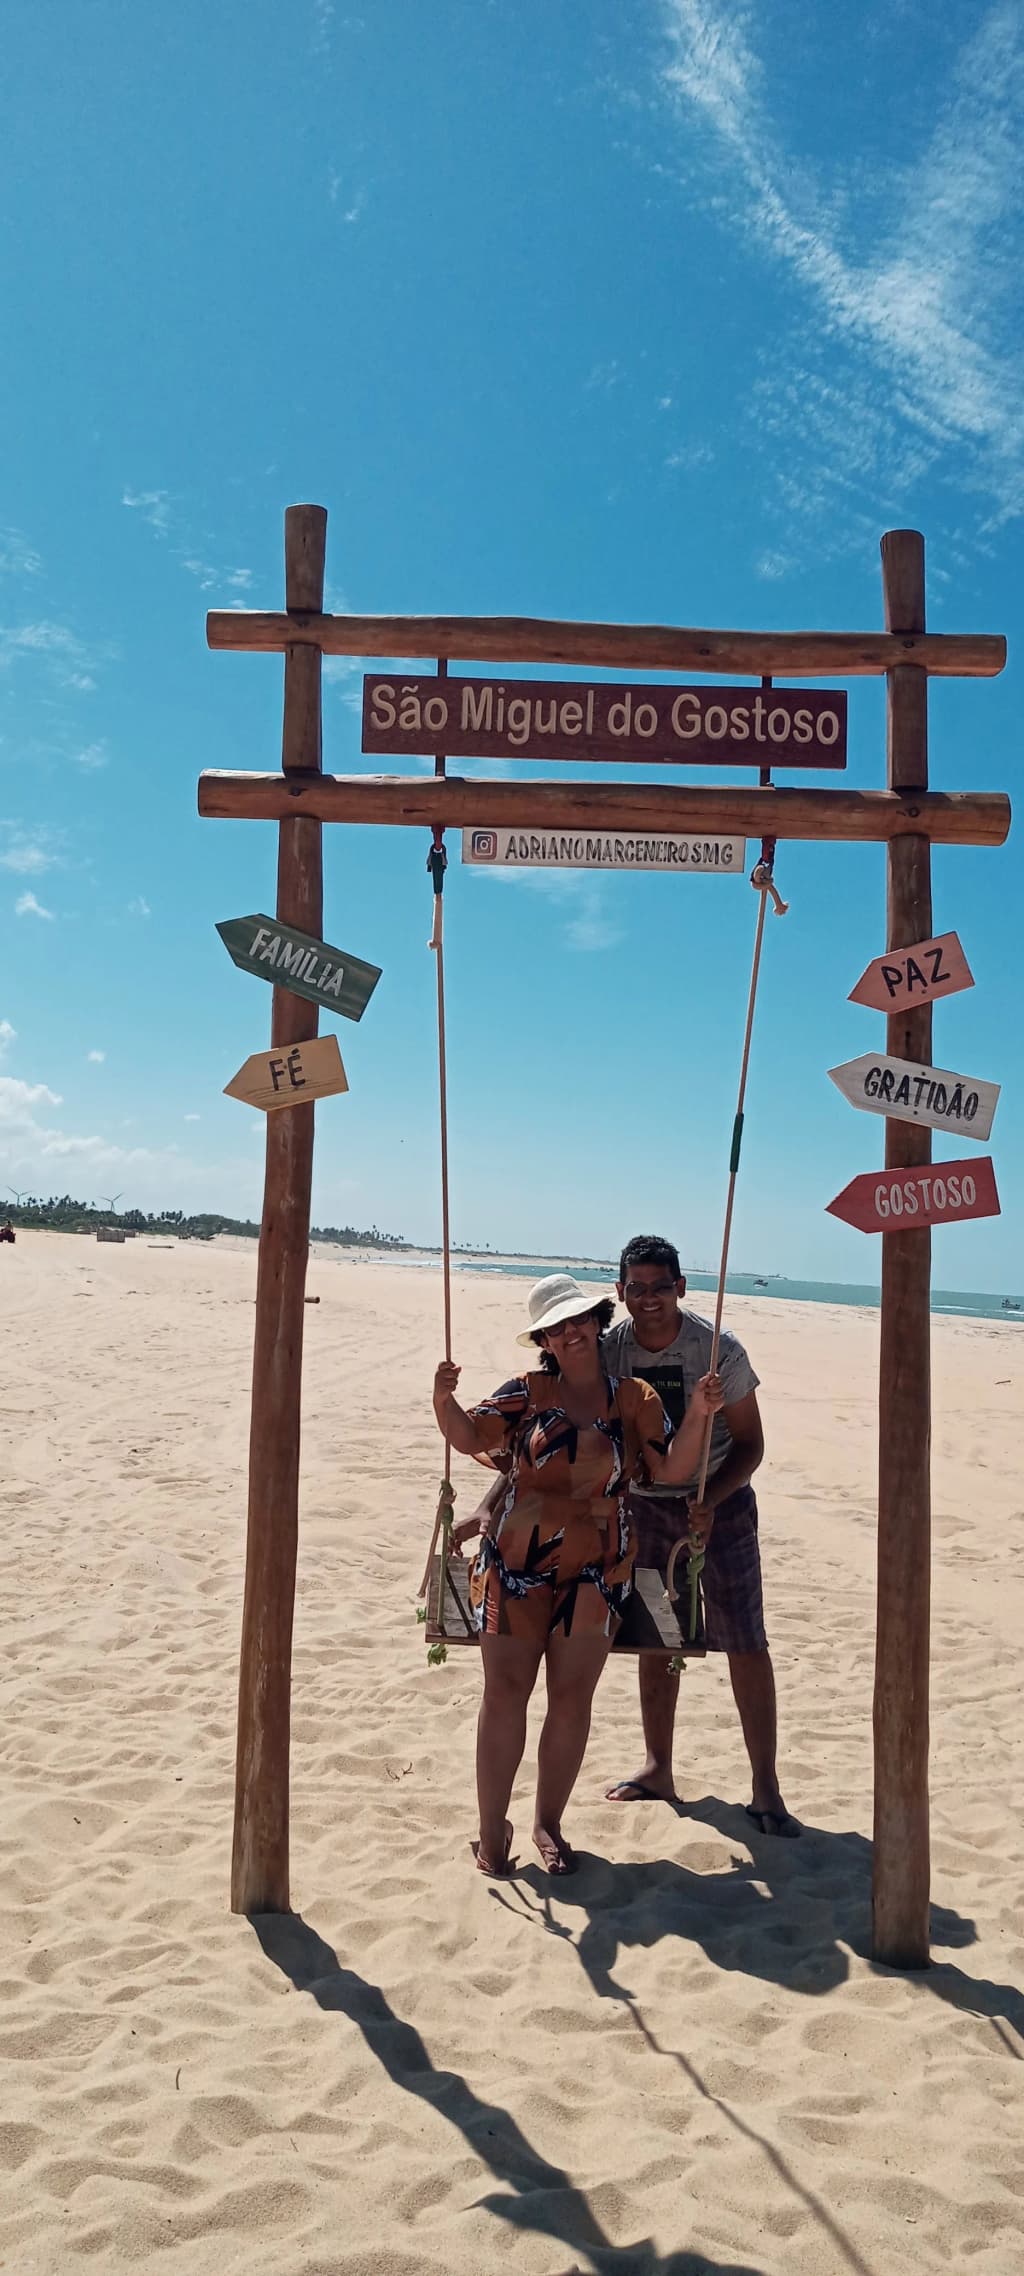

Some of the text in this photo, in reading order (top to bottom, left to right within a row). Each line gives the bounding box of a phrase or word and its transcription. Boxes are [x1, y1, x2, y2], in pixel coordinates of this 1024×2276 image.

[370, 683, 840, 746] São Miguel do Gostoso
[504, 835, 734, 865] ADRIANOMARCENEIROSMG
[249, 928, 344, 997] FAMÍLIA
[881, 948, 951, 998] PAZ
[269, 1048, 306, 1092] FÉ
[864, 1067, 979, 1122] GRATIDÃO
[874, 1175, 977, 1218] GOSTOSO
